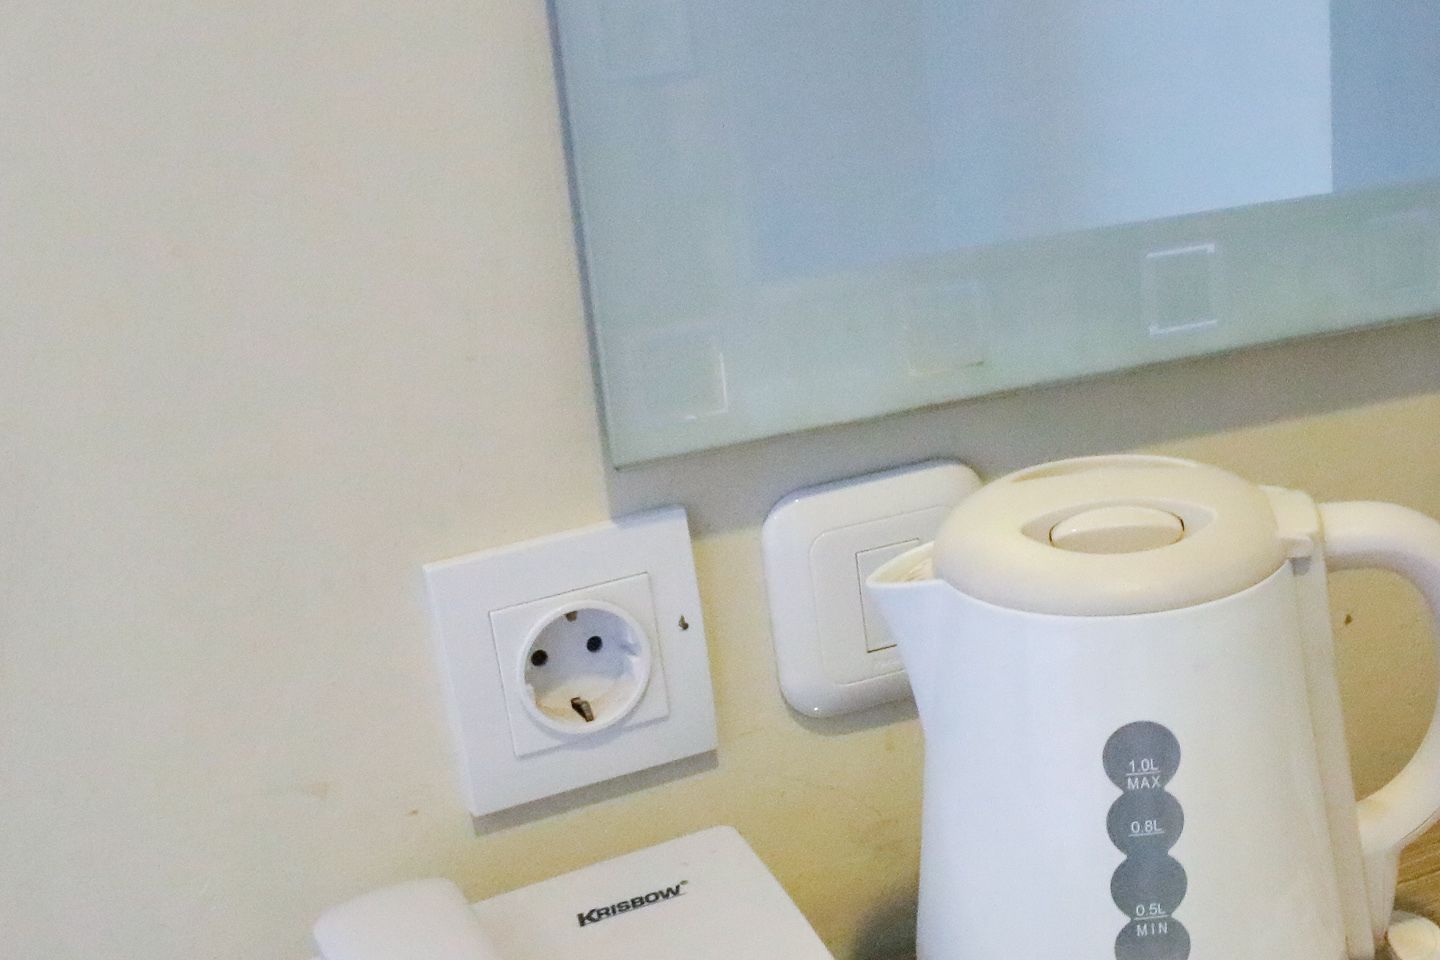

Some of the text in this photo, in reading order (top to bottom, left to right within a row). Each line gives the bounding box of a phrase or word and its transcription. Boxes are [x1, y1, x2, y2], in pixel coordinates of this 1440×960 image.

[1128, 758, 1159, 772] 1.0L
[1127, 775, 1161, 791] MAX
[1130, 820, 1162, 833] 0.8L
[577, 884, 682, 927] KRISBOW
[1135, 903, 1167, 916] 0.5L
[1136, 922, 1168, 937] MIN
